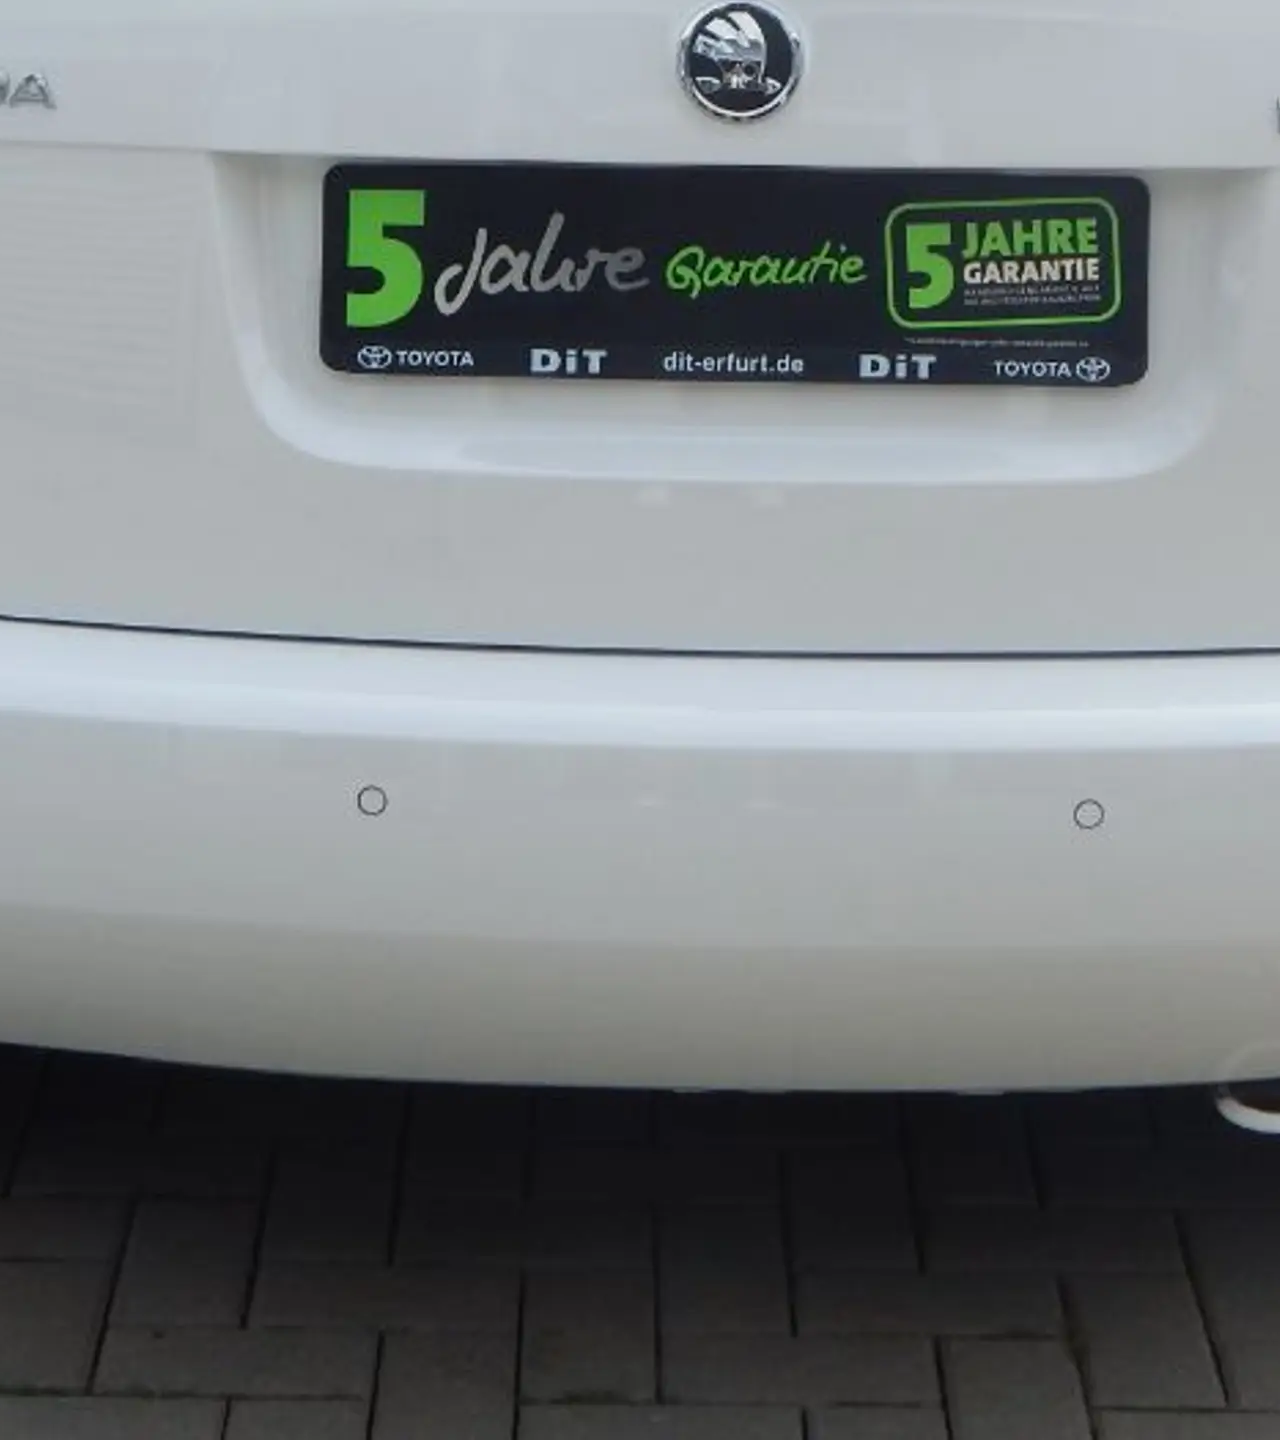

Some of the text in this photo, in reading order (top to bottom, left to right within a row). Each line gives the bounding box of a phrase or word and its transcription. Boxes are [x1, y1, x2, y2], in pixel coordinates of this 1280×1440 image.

[347, 189, 868, 328] 5 Jahre Garantie
[906, 217, 1099, 309] 5 JAHRE
[963, 257, 1100, 284] GARANTIE
[396, 349, 474, 366] TOYOTA
[664, 351, 804, 373] dit-erfurt.de
[993, 360, 1071, 378] TOYOTA
